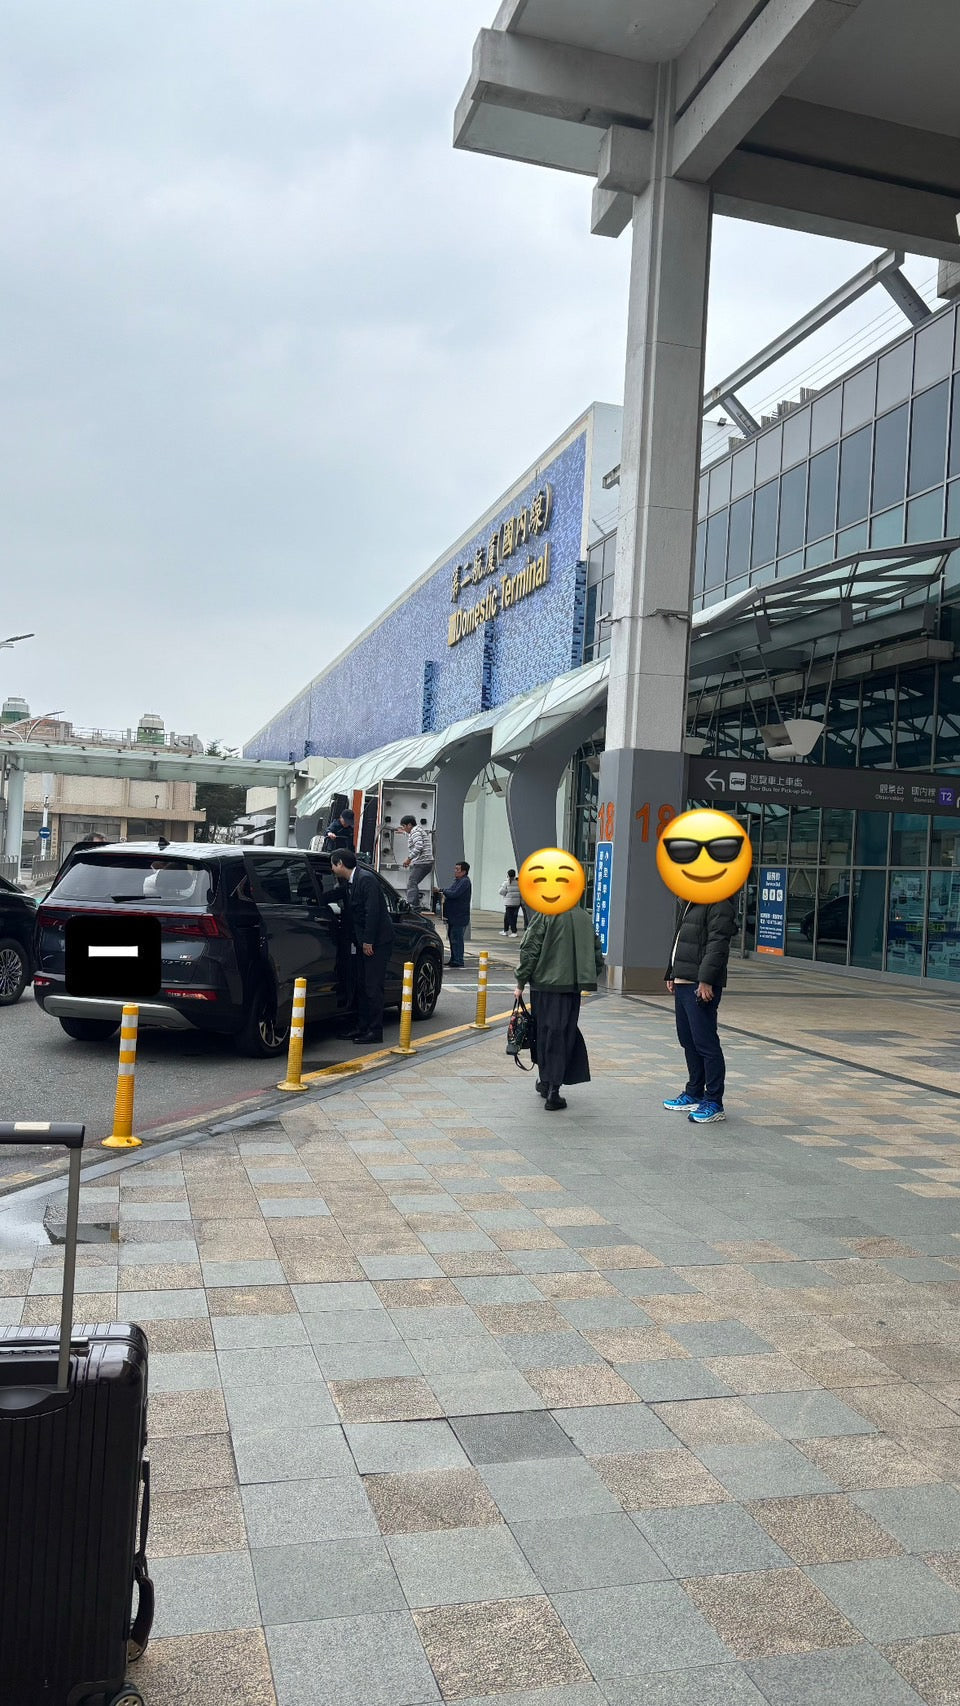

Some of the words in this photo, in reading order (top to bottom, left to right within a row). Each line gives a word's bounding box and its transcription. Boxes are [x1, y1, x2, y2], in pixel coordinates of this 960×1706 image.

[448, 584, 499, 646] Domestic
[501, 542, 552, 611] Terminal
[941, 791, 952, 802] T2
[598, 802, 614, 841] 18
